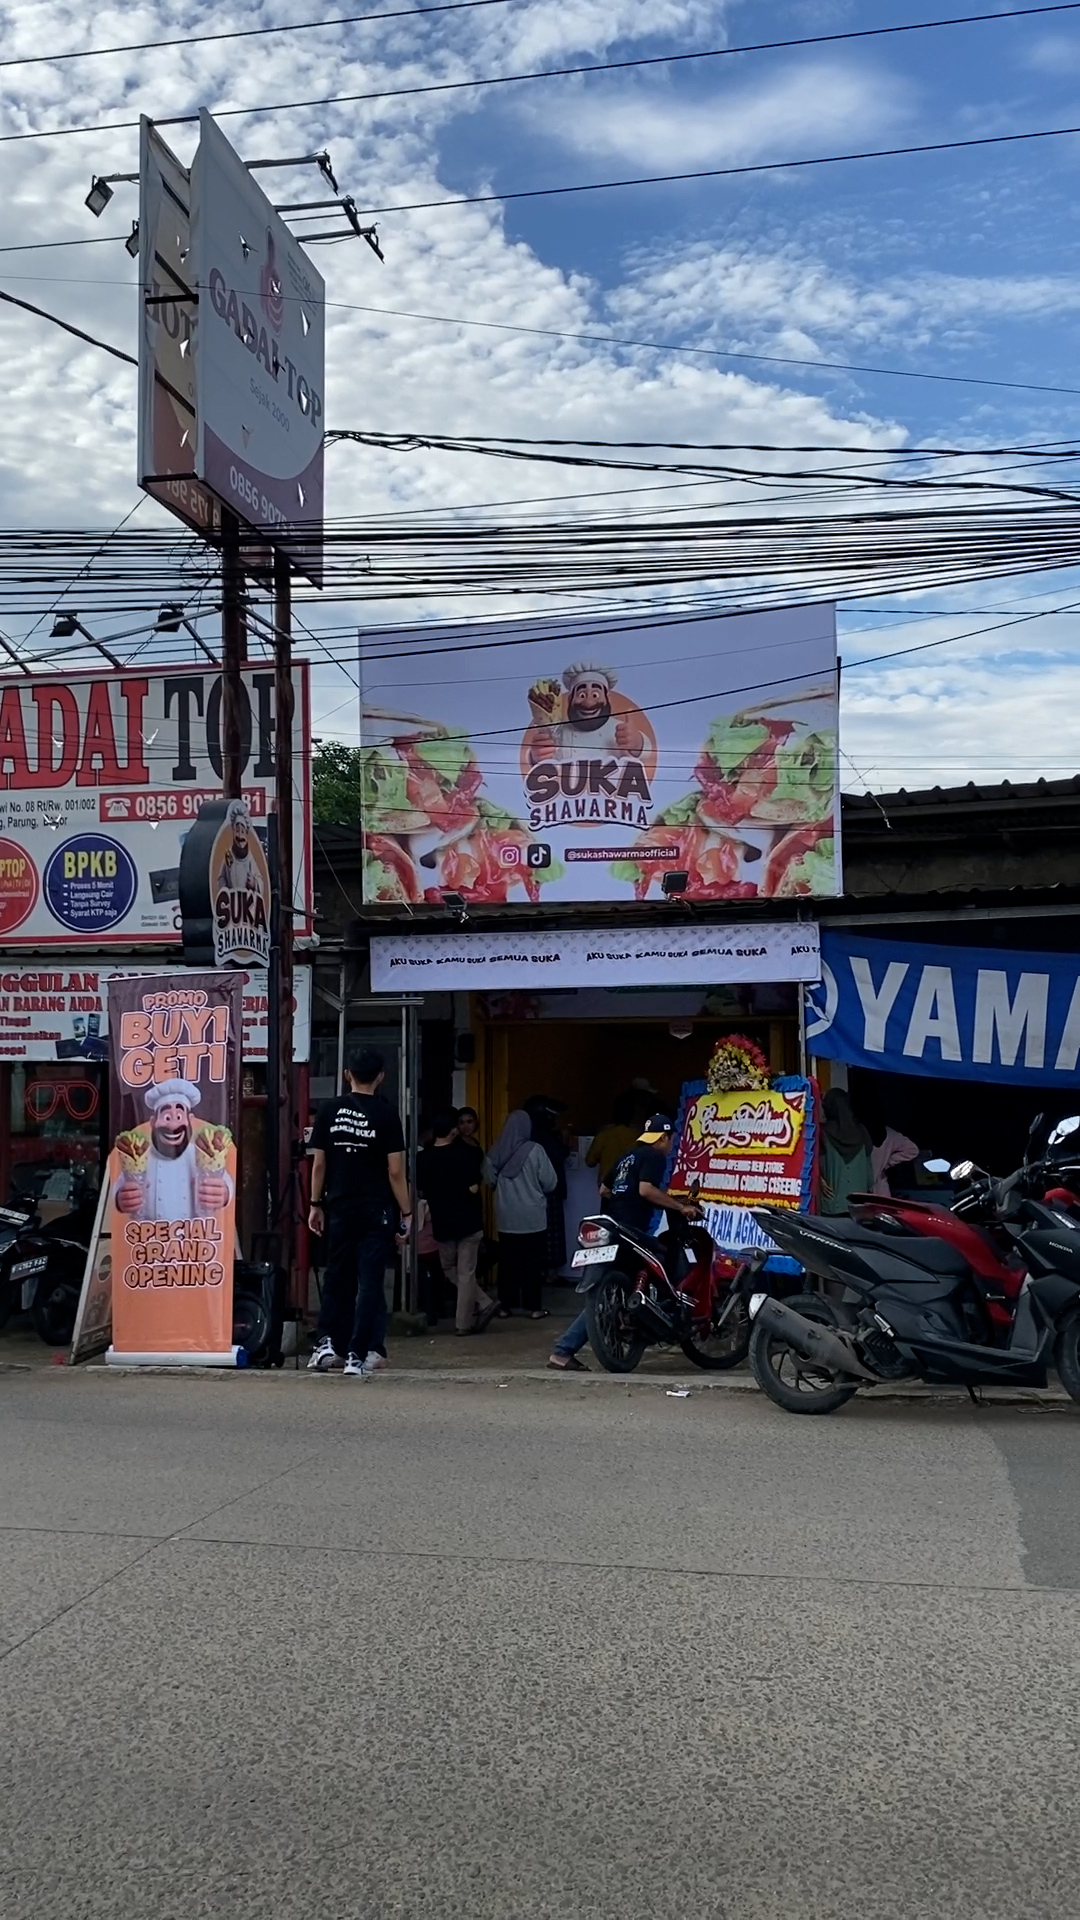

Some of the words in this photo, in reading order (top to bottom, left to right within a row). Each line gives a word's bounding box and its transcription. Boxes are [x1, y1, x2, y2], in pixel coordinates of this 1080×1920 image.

[208, 267, 280, 383] GADAI
[285, 355, 322, 428] TOP
[250, 378, 270, 410] Sejak
[271, 402, 290, 433] 2000
[229, 465, 259, 510] 0856
[164, 673, 295, 781] TOP
[526, 759, 652, 803] SUKA
[25, 801, 36, 812] 08
[65, 799, 96, 810] 001/002
[135, 793, 178, 817] 0856
[529, 798, 649, 827] SHAWARMA
[8, 817, 39, 829] Parung,
[64, 850, 118, 878] BPKB
[567, 848, 677, 860] @sukashawarmaofficial
[91, 908, 104, 916] KTP
[215, 890, 269, 934] SUKA
[218, 929, 270, 957] SHAWARMA
[586, 952, 604, 962] AKU
[635, 951, 666, 959] KAMU
[668, 950, 688, 958] SUKA
[691, 948, 733, 957] SEMUA
[736, 947, 768, 957] SUKA
[791, 946, 810, 956] AKU
[390, 957, 407, 967] AKU
[408, 958, 433, 966] SUKA
[435, 957, 465, 965] KAMU
[489, 954, 529, 963] SEMUA
[531, 953, 561, 963] SUKA
[0, 973, 99, 992] GGULAN
[13, 996, 66, 1012] BARANG
[69, 996, 103, 1012] ANDA
[144, 990, 207, 1011] PROMO
[126, 1219, 221, 1243] SPECIAL
[710, 1209, 734, 1243] RAYA
[131, 1240, 216, 1265] GRAND
[124, 1263, 225, 1289] OPENING
